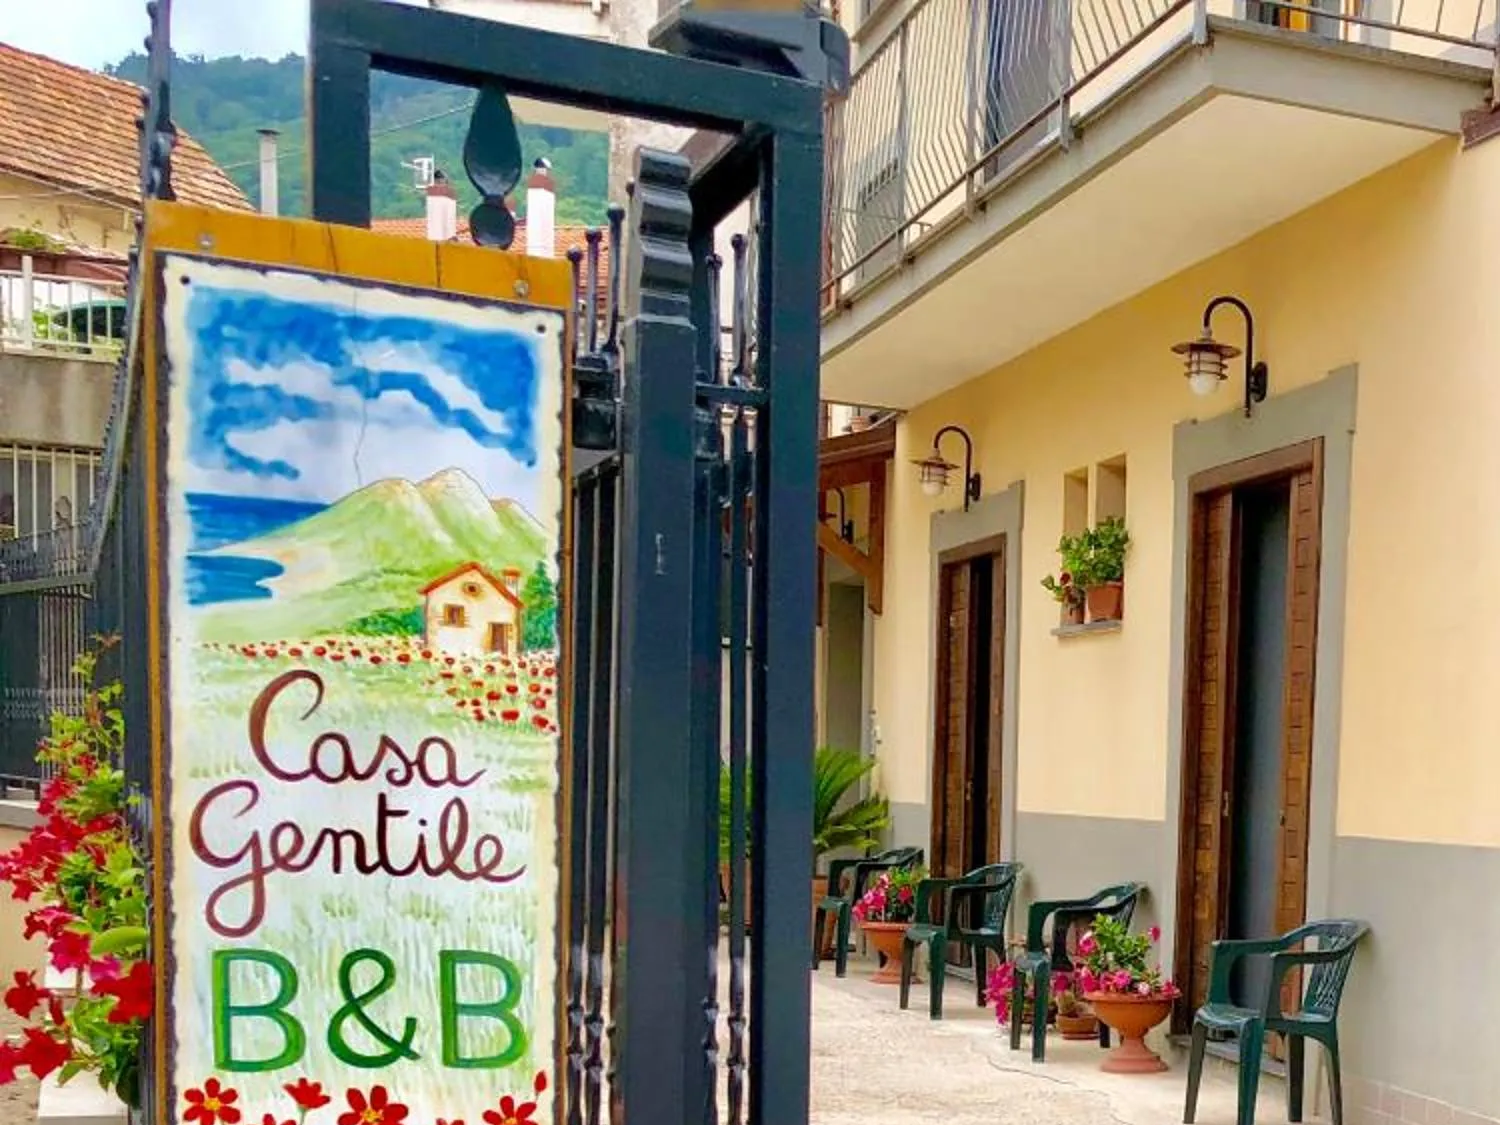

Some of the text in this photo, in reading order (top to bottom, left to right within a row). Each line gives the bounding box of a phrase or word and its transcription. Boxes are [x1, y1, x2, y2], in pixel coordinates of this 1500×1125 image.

[249, 669, 486, 789] Casa
[189, 780, 526, 938] Gentile
[211, 947, 527, 1073] B&B
